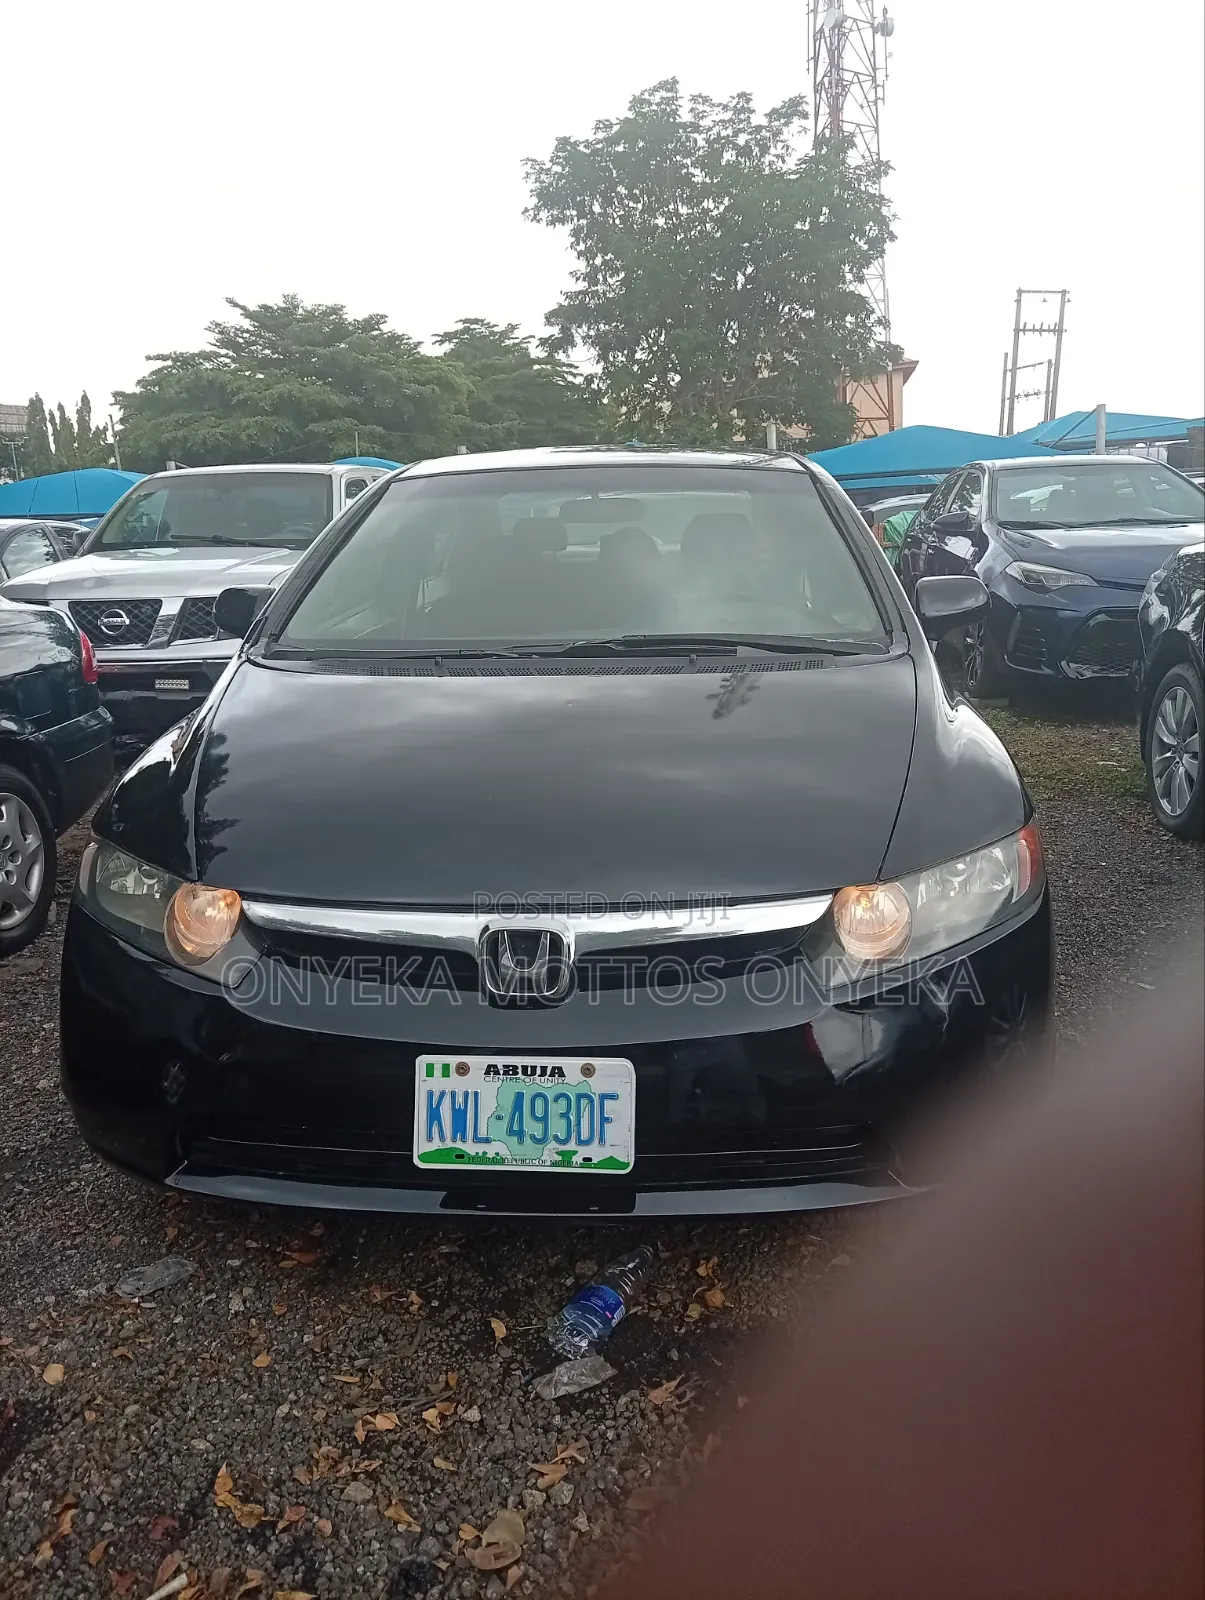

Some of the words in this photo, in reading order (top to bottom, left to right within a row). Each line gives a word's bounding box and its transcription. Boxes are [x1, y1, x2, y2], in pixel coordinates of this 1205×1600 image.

[483, 1063, 566, 1078] ABUJA
[483, 1075, 521, 1084] CENTRE
[523, 1076, 537, 1084] OF
[539, 1077, 566, 1085] UNITY
[467, 1156, 501, 1164] FEDERAL
[501, 1157, 536, 1166] REPUBLIC
[537, 1158, 547, 1166] OF
[549, 1159, 579, 1168] NIGERIA
